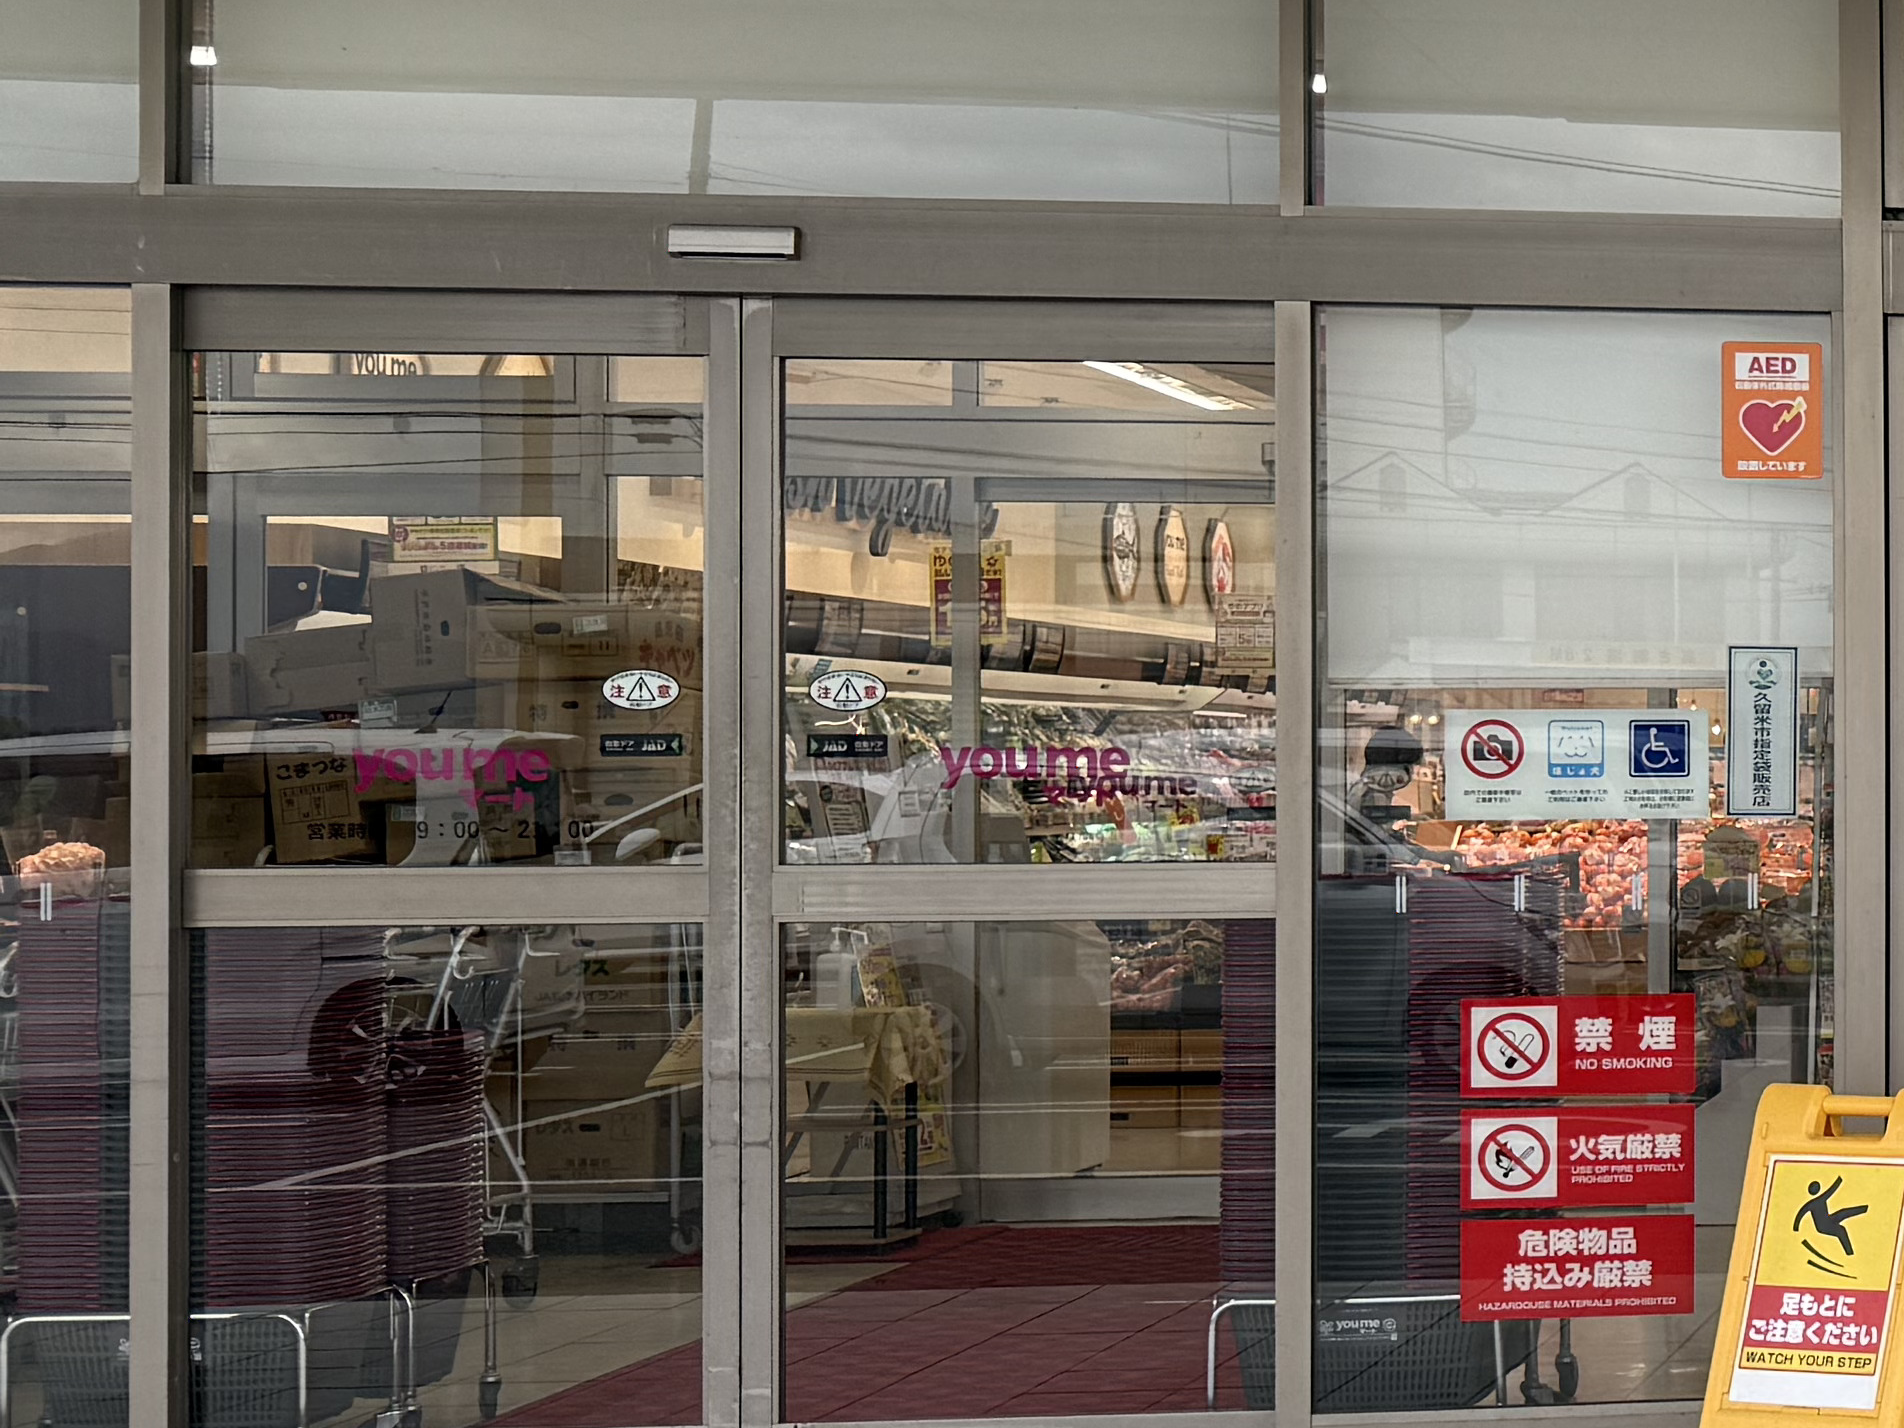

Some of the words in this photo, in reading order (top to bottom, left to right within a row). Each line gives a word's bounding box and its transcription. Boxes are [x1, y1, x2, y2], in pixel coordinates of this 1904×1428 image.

[1748, 356, 1797, 374] AED
[640, 739, 667, 752] JAD
[822, 740, 848, 752] JAD
[1752, 692, 1772, 807] 久留米市指定袋販売店
[276, 757, 348, 781] こまつな
[1574, 1015, 1677, 1053] 禁煙
[1575, 1058, 1598, 1070] NO
[1601, 1056, 1673, 1070] SMOKING
[1568, 1132, 1682, 1161] 火気厳禁
[1571, 1165, 1592, 1174] USE
[1594, 1164, 1610, 1173] OF
[1611, 1164, 1634, 1173] FIRE
[1635, 1163, 1686, 1173] STRICTLY
[1571, 1174, 1633, 1184] PROHIBITED
[1518, 1227, 1637, 1257] 危険物品
[1503, 1259, 1653, 1292] 持込み厳禁
[1553, 1299, 1613, 1309] MATERIALS
[1615, 1296, 1677, 1307] PROHIBITED
[1780, 1292, 1856, 1317] 足もとに
[1748, 1318, 1878, 1346] ご注意ください
[1746, 1350, 1794, 1365] WATCH
[1798, 1354, 1834, 1368] YOUR
[1837, 1356, 1872, 1369] STEP
